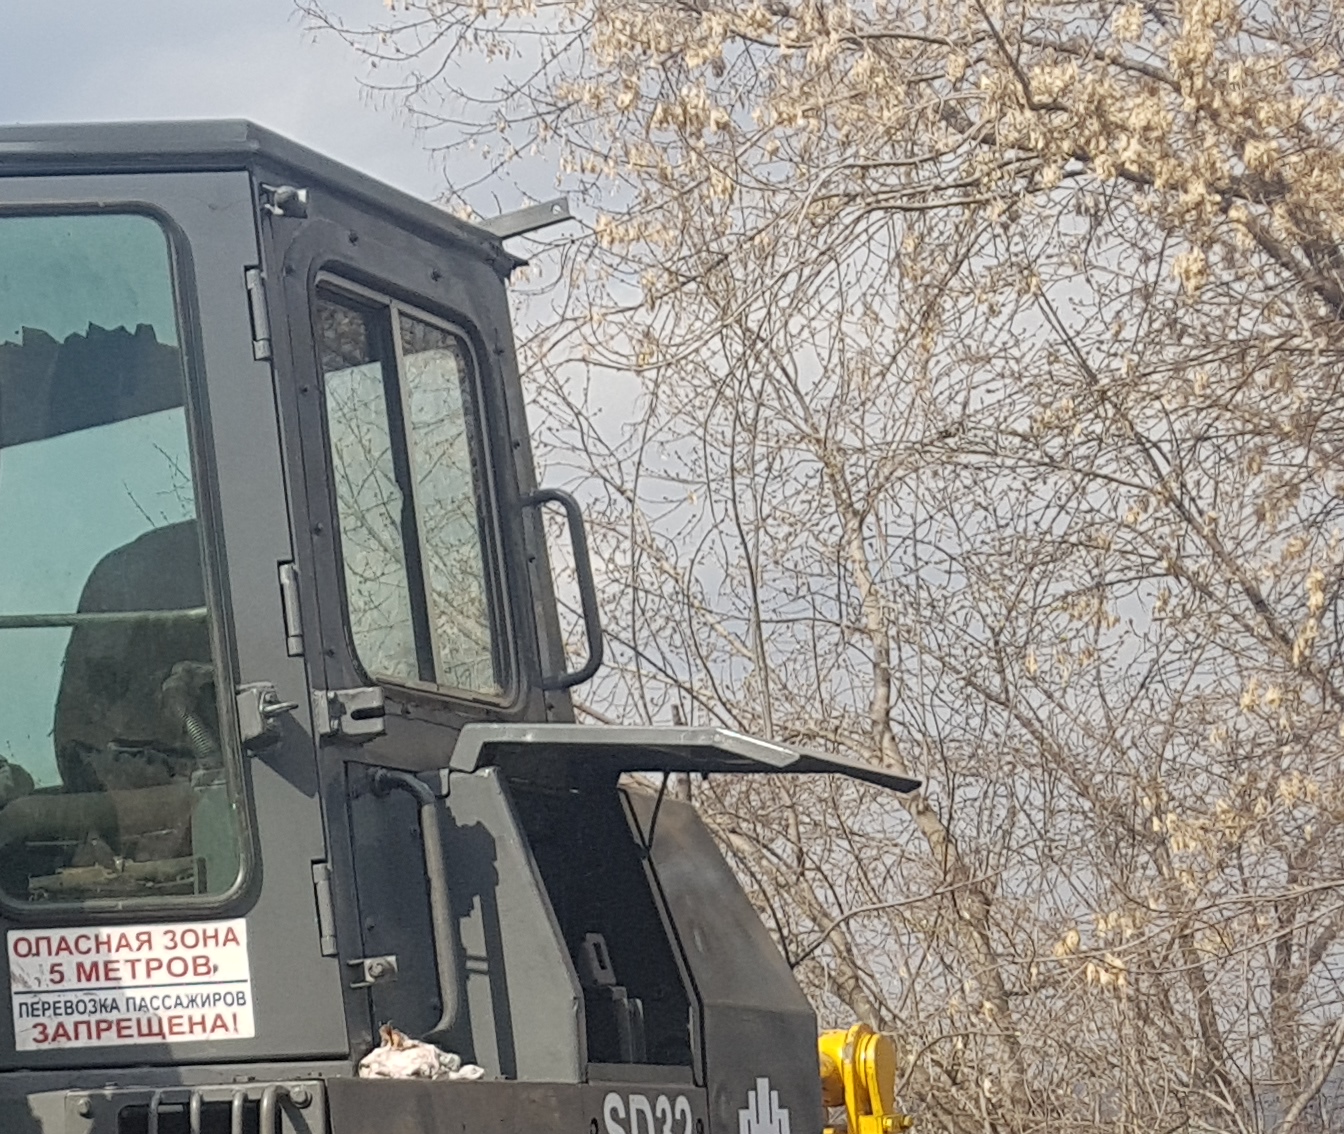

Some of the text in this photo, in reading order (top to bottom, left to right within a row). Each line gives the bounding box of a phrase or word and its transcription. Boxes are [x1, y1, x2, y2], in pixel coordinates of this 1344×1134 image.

[13, 927, 240, 958] ОПАСНАЯ ЗОНА
[49, 962, 65, 985] 5
[19, 991, 247, 1018] ПЕРЕВОЗКА ПАССАЖИРОВ
[31, 1013, 239, 1044] ЗАПРЕЩЕНА!
